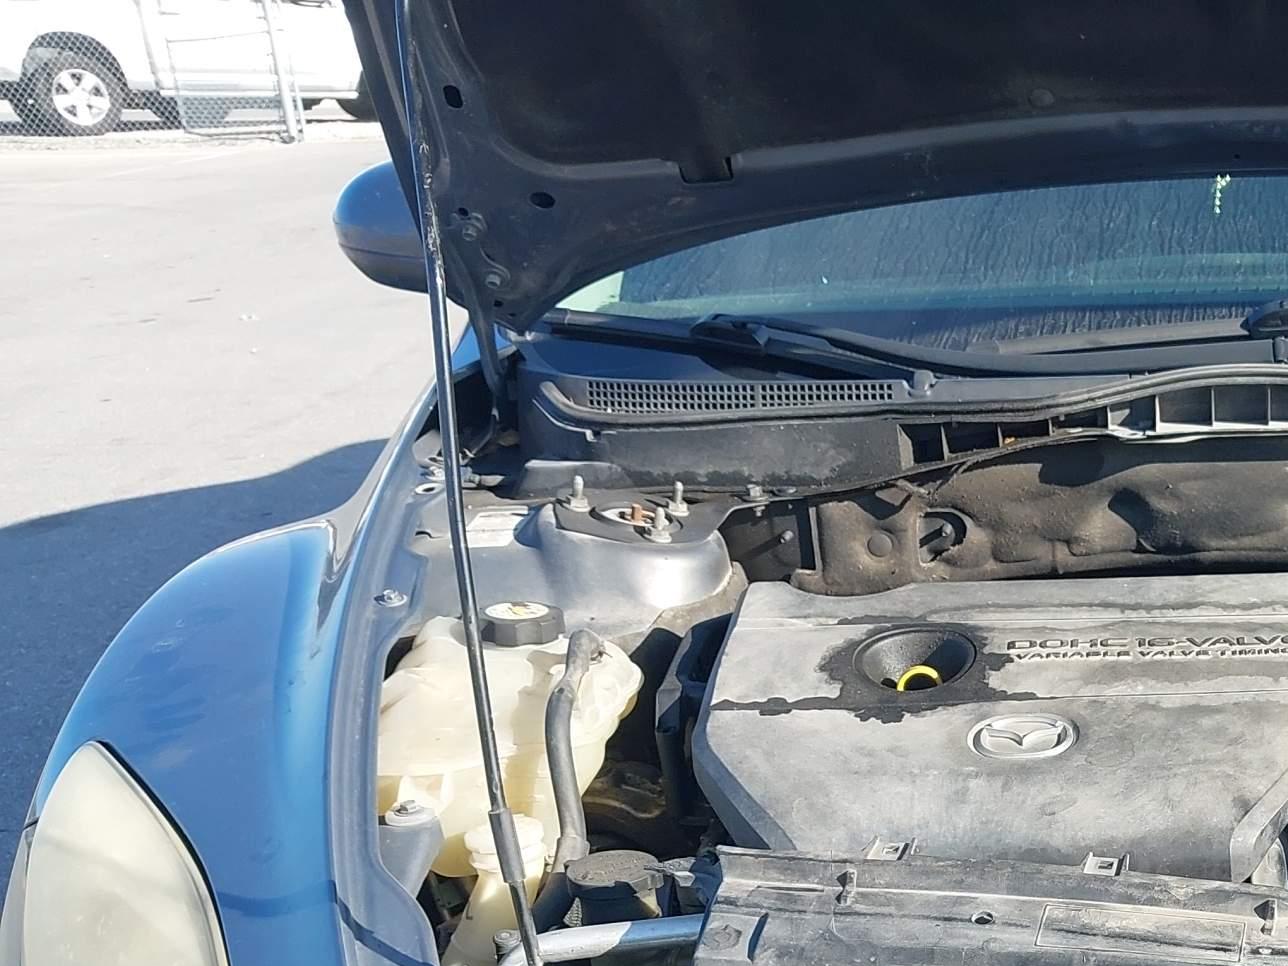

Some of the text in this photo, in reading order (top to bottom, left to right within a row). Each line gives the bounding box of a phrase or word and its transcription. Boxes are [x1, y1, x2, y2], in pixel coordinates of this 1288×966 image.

[1007, 637, 1128, 650] DOHC
[1015, 650, 1131, 660] VARIABLE
[1139, 649, 1210, 658] VALVE
